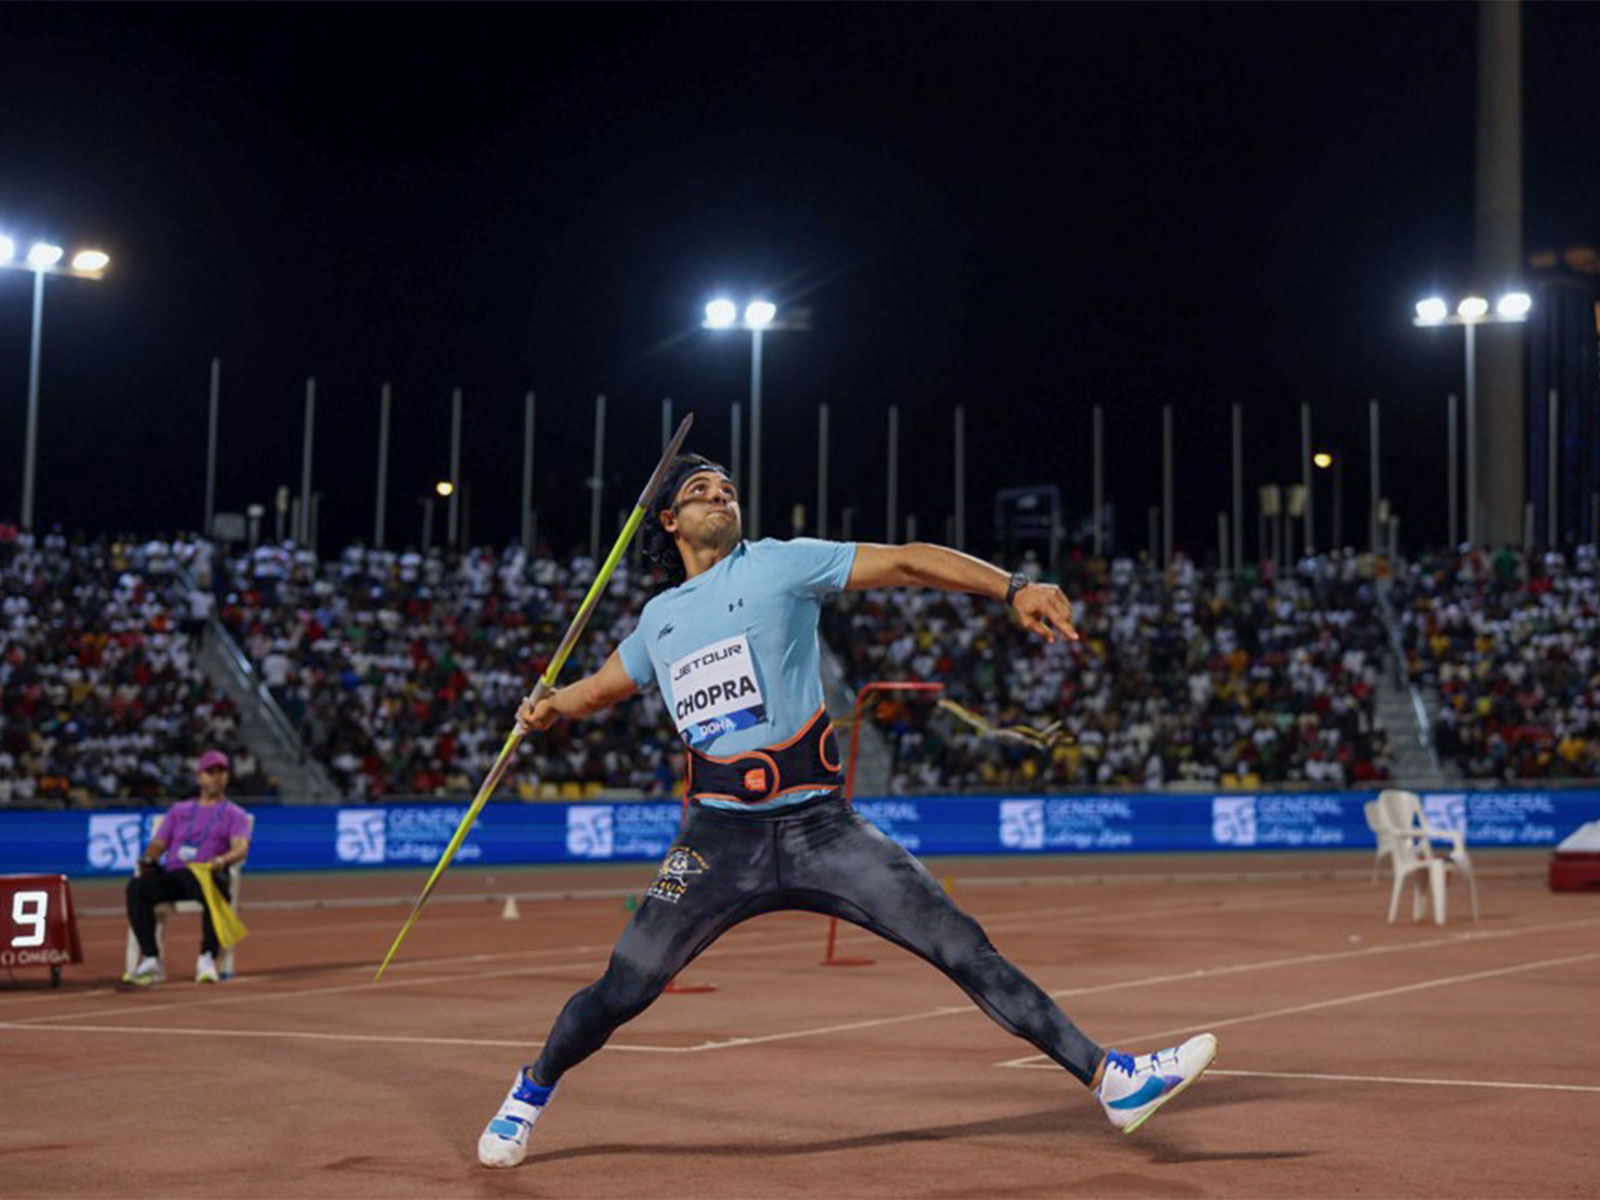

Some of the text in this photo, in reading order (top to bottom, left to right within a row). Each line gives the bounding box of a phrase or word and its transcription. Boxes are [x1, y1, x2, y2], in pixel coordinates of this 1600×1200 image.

[674, 643, 742, 680] JETOUR
[676, 675, 756, 720] CHOPRA
[700, 717, 736, 737] DOHA
[11, 891, 48, 948] 9
[18, 948, 71, 964] OMEGA
